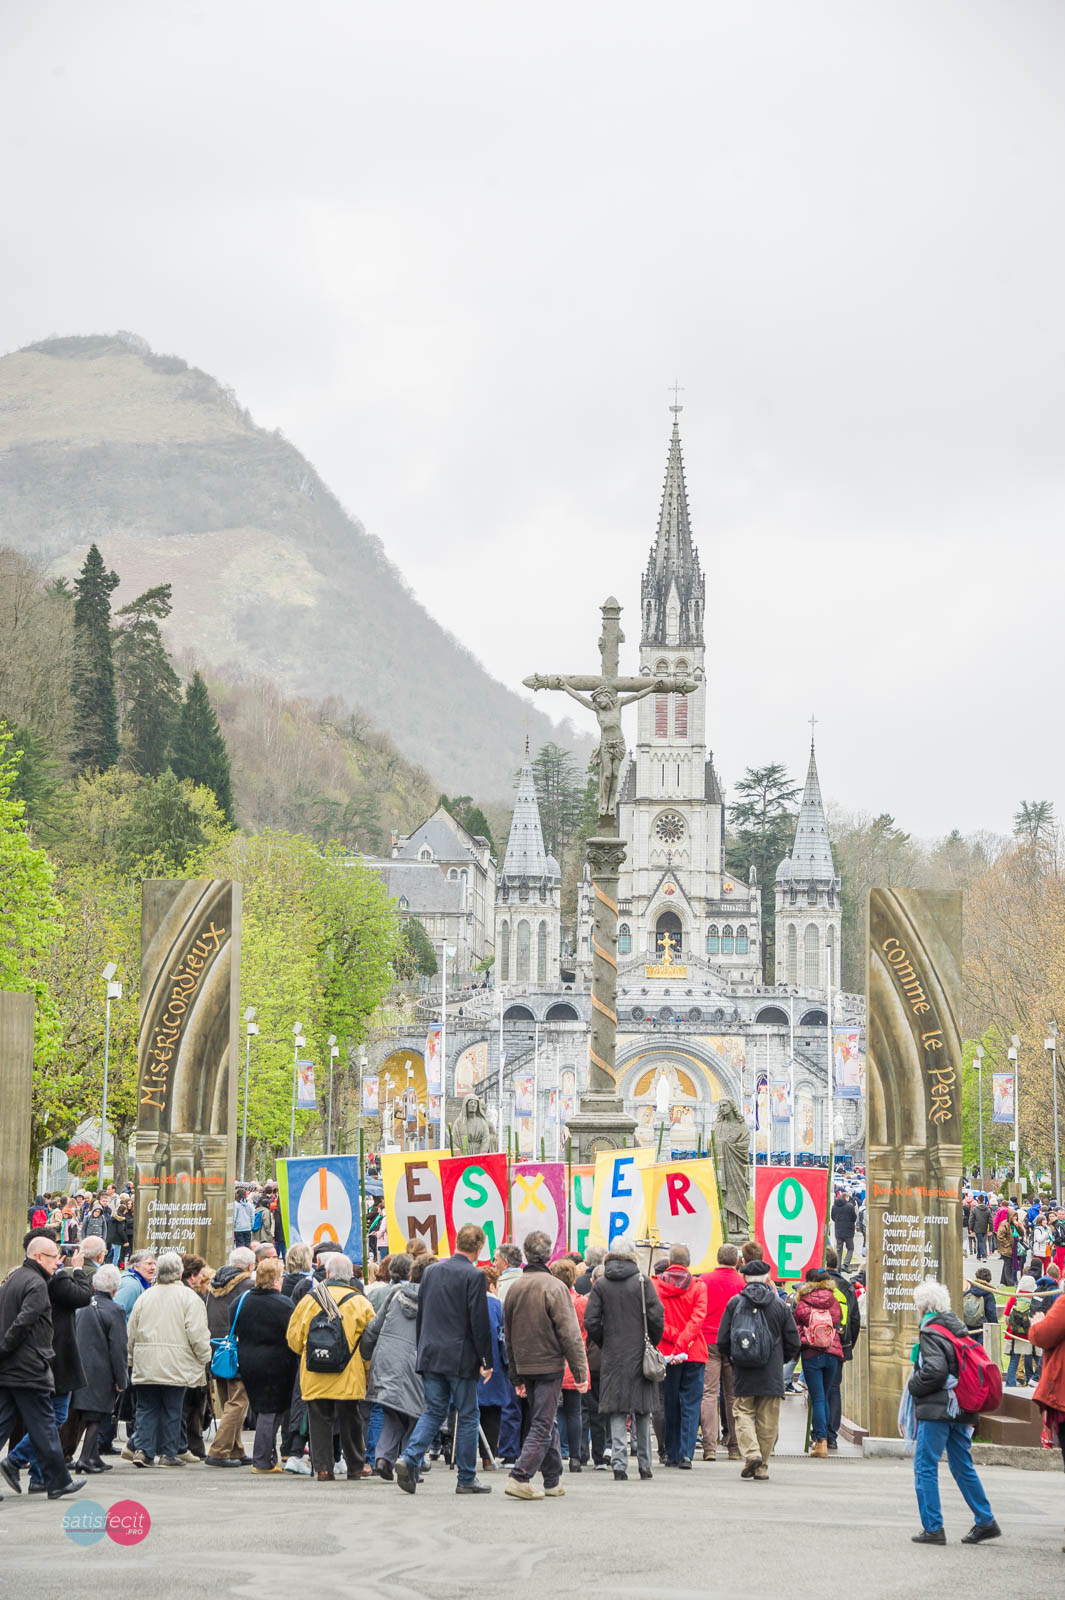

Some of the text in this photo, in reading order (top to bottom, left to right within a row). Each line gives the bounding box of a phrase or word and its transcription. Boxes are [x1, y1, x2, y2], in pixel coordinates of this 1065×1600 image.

[921, 1029, 944, 1052] le
[404, 1161, 432, 1203] E
[462, 1165, 489, 1208] S
[611, 1157, 635, 1198] E
[514, 1172, 547, 1214] X
[665, 1172, 697, 1217] R
[777, 1177, 803, 1220] O
[147, 1200, 180, 1215] Chiunque
[167, 1215, 213, 1230] sperimentare
[882, 1211, 949, 1227] Quiconque entrera
[146, 1228, 196, 1240] l'amore di Dio
[407, 1215, 439, 1256] M
[882, 1226, 926, 1242] pourra faire
[777, 1234, 803, 1278] E
[924, 1241, 933, 1253] de
[882, 1254, 939, 1268] l'amour de Dieu
[882, 1270, 895, 1284] qui
[883, 1284, 915, 1300] pardonn
